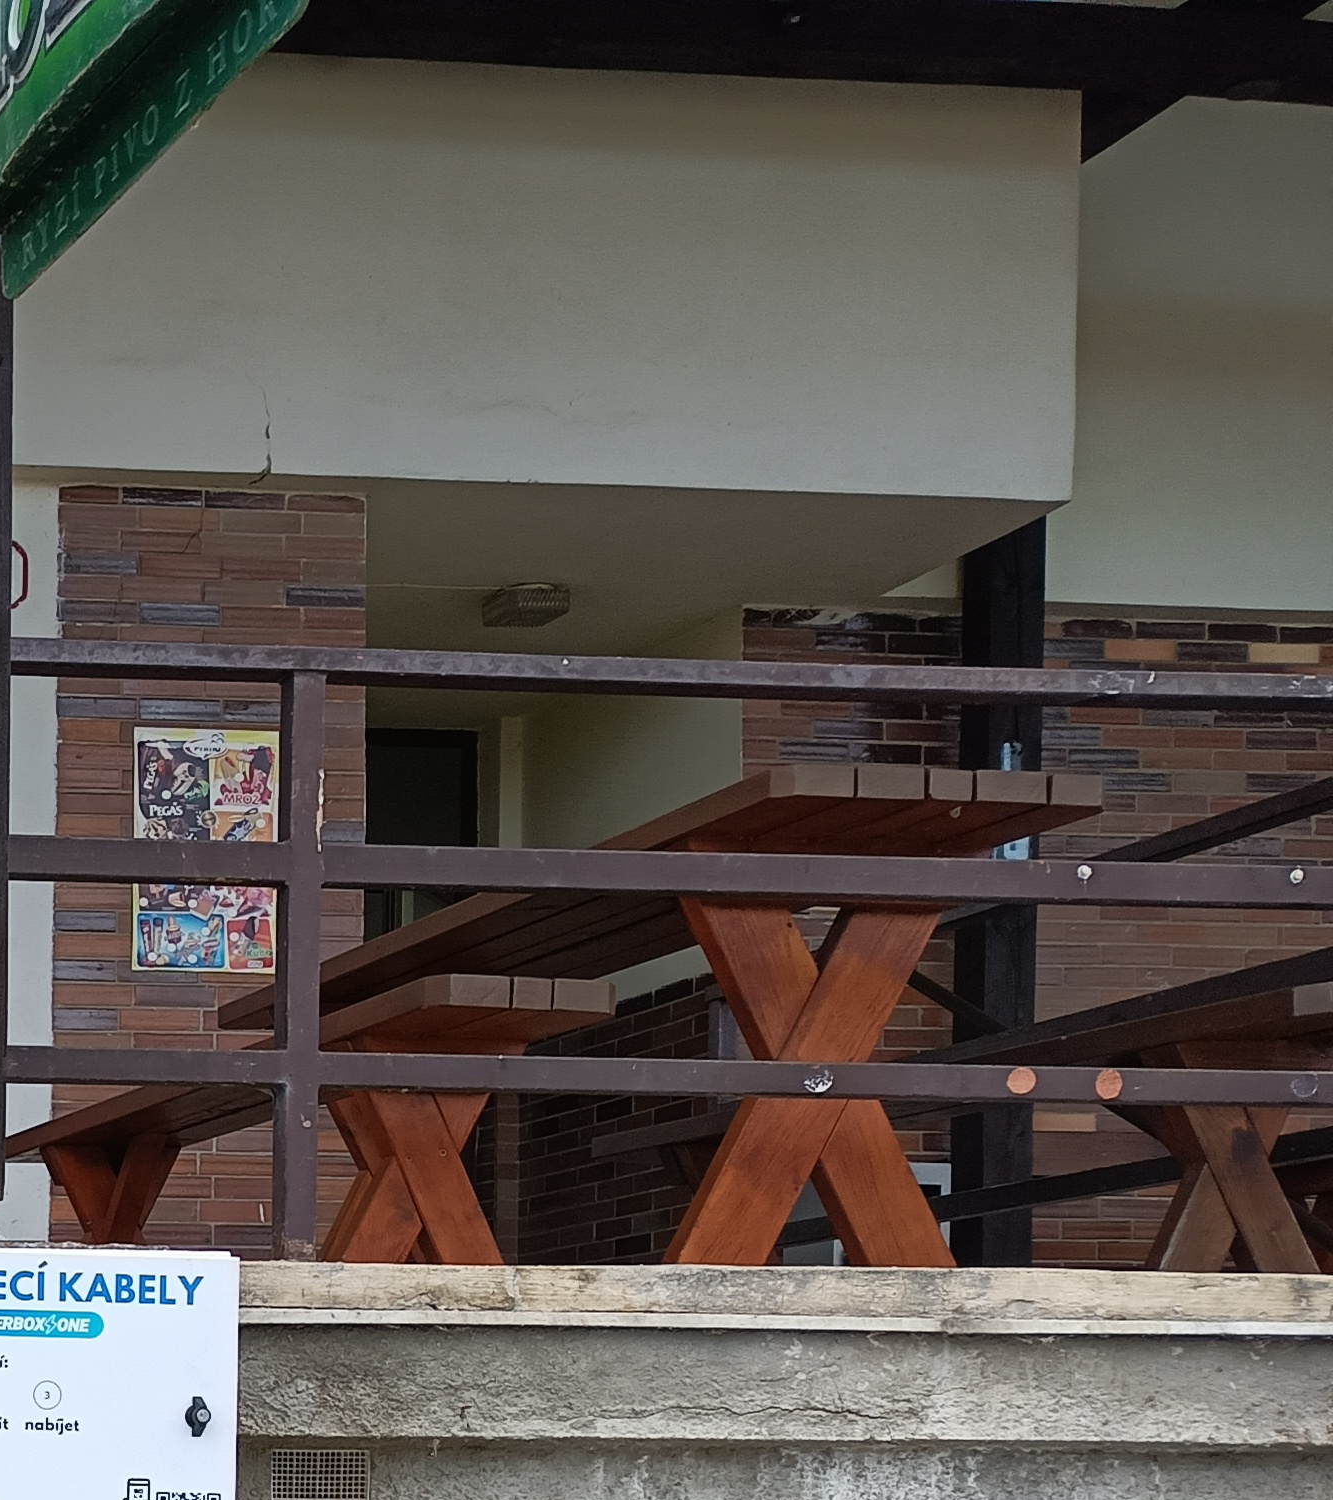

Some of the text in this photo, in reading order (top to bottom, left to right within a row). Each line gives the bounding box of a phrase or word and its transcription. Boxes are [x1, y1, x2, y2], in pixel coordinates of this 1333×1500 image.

[93, 104, 160, 199] PIVO
[174, 69, 194, 119] Z
[207, 0, 279, 86] HOR
[59, 1272, 204, 1305] KABELY
[44, 1391, 50, 1400] 3
[25, 1417, 79, 1434] nabíjet
